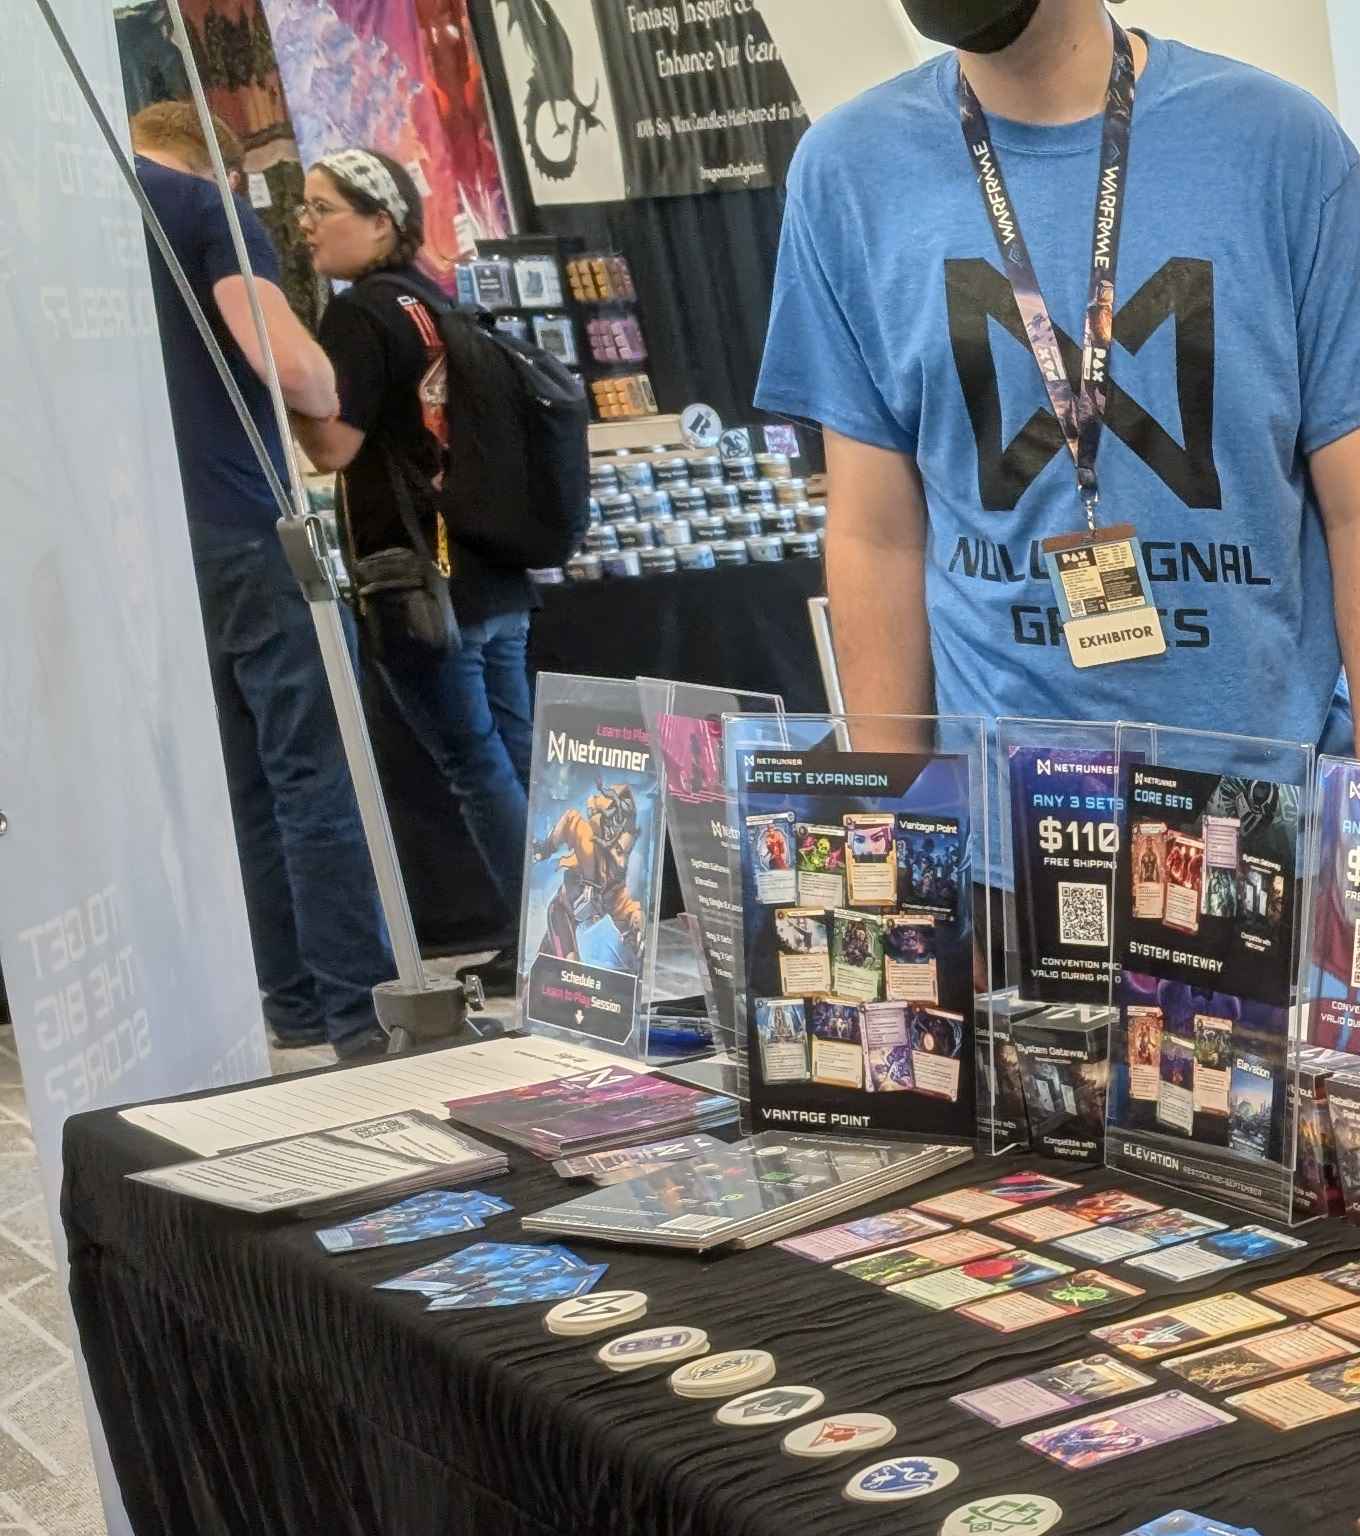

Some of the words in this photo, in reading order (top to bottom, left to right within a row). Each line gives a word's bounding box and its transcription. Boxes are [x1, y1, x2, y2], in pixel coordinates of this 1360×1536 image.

[656, 49, 714, 78] Enhance
[1094, 165, 1120, 269] WARFRAME
[1079, 625, 1154, 649] EXHIBITOR
[568, 738, 650, 772] Netrunner
[745, 771, 801, 784] LATEST
[806, 772, 888, 787] EXPANSION
[1054, 763, 1119, 775] NETRUNNER
[1033, 794, 1064, 808] ANY
[1070, 796, 1080, 808] 3
[1085, 797, 1124, 811] SETS
[1134, 788, 1162, 805] CORE
[1165, 792, 1193, 810] SETS
[1039, 815, 1119, 854] $110
[1043, 857, 1070, 868] FREE
[1041, 957, 1100, 969] CONVENTION
[1129, 941, 1170, 961] SYSTEM
[1172, 950, 1224, 973] GATEWAY
[1321, 1013, 1345, 1025] VALID
[1236, 1058, 1271, 1080] Elevation
[761, 1107, 827, 1125] VANTAGE
[830, 1111, 871, 1128] POINT
[1123, 1143, 1179, 1171] ELEVATION
